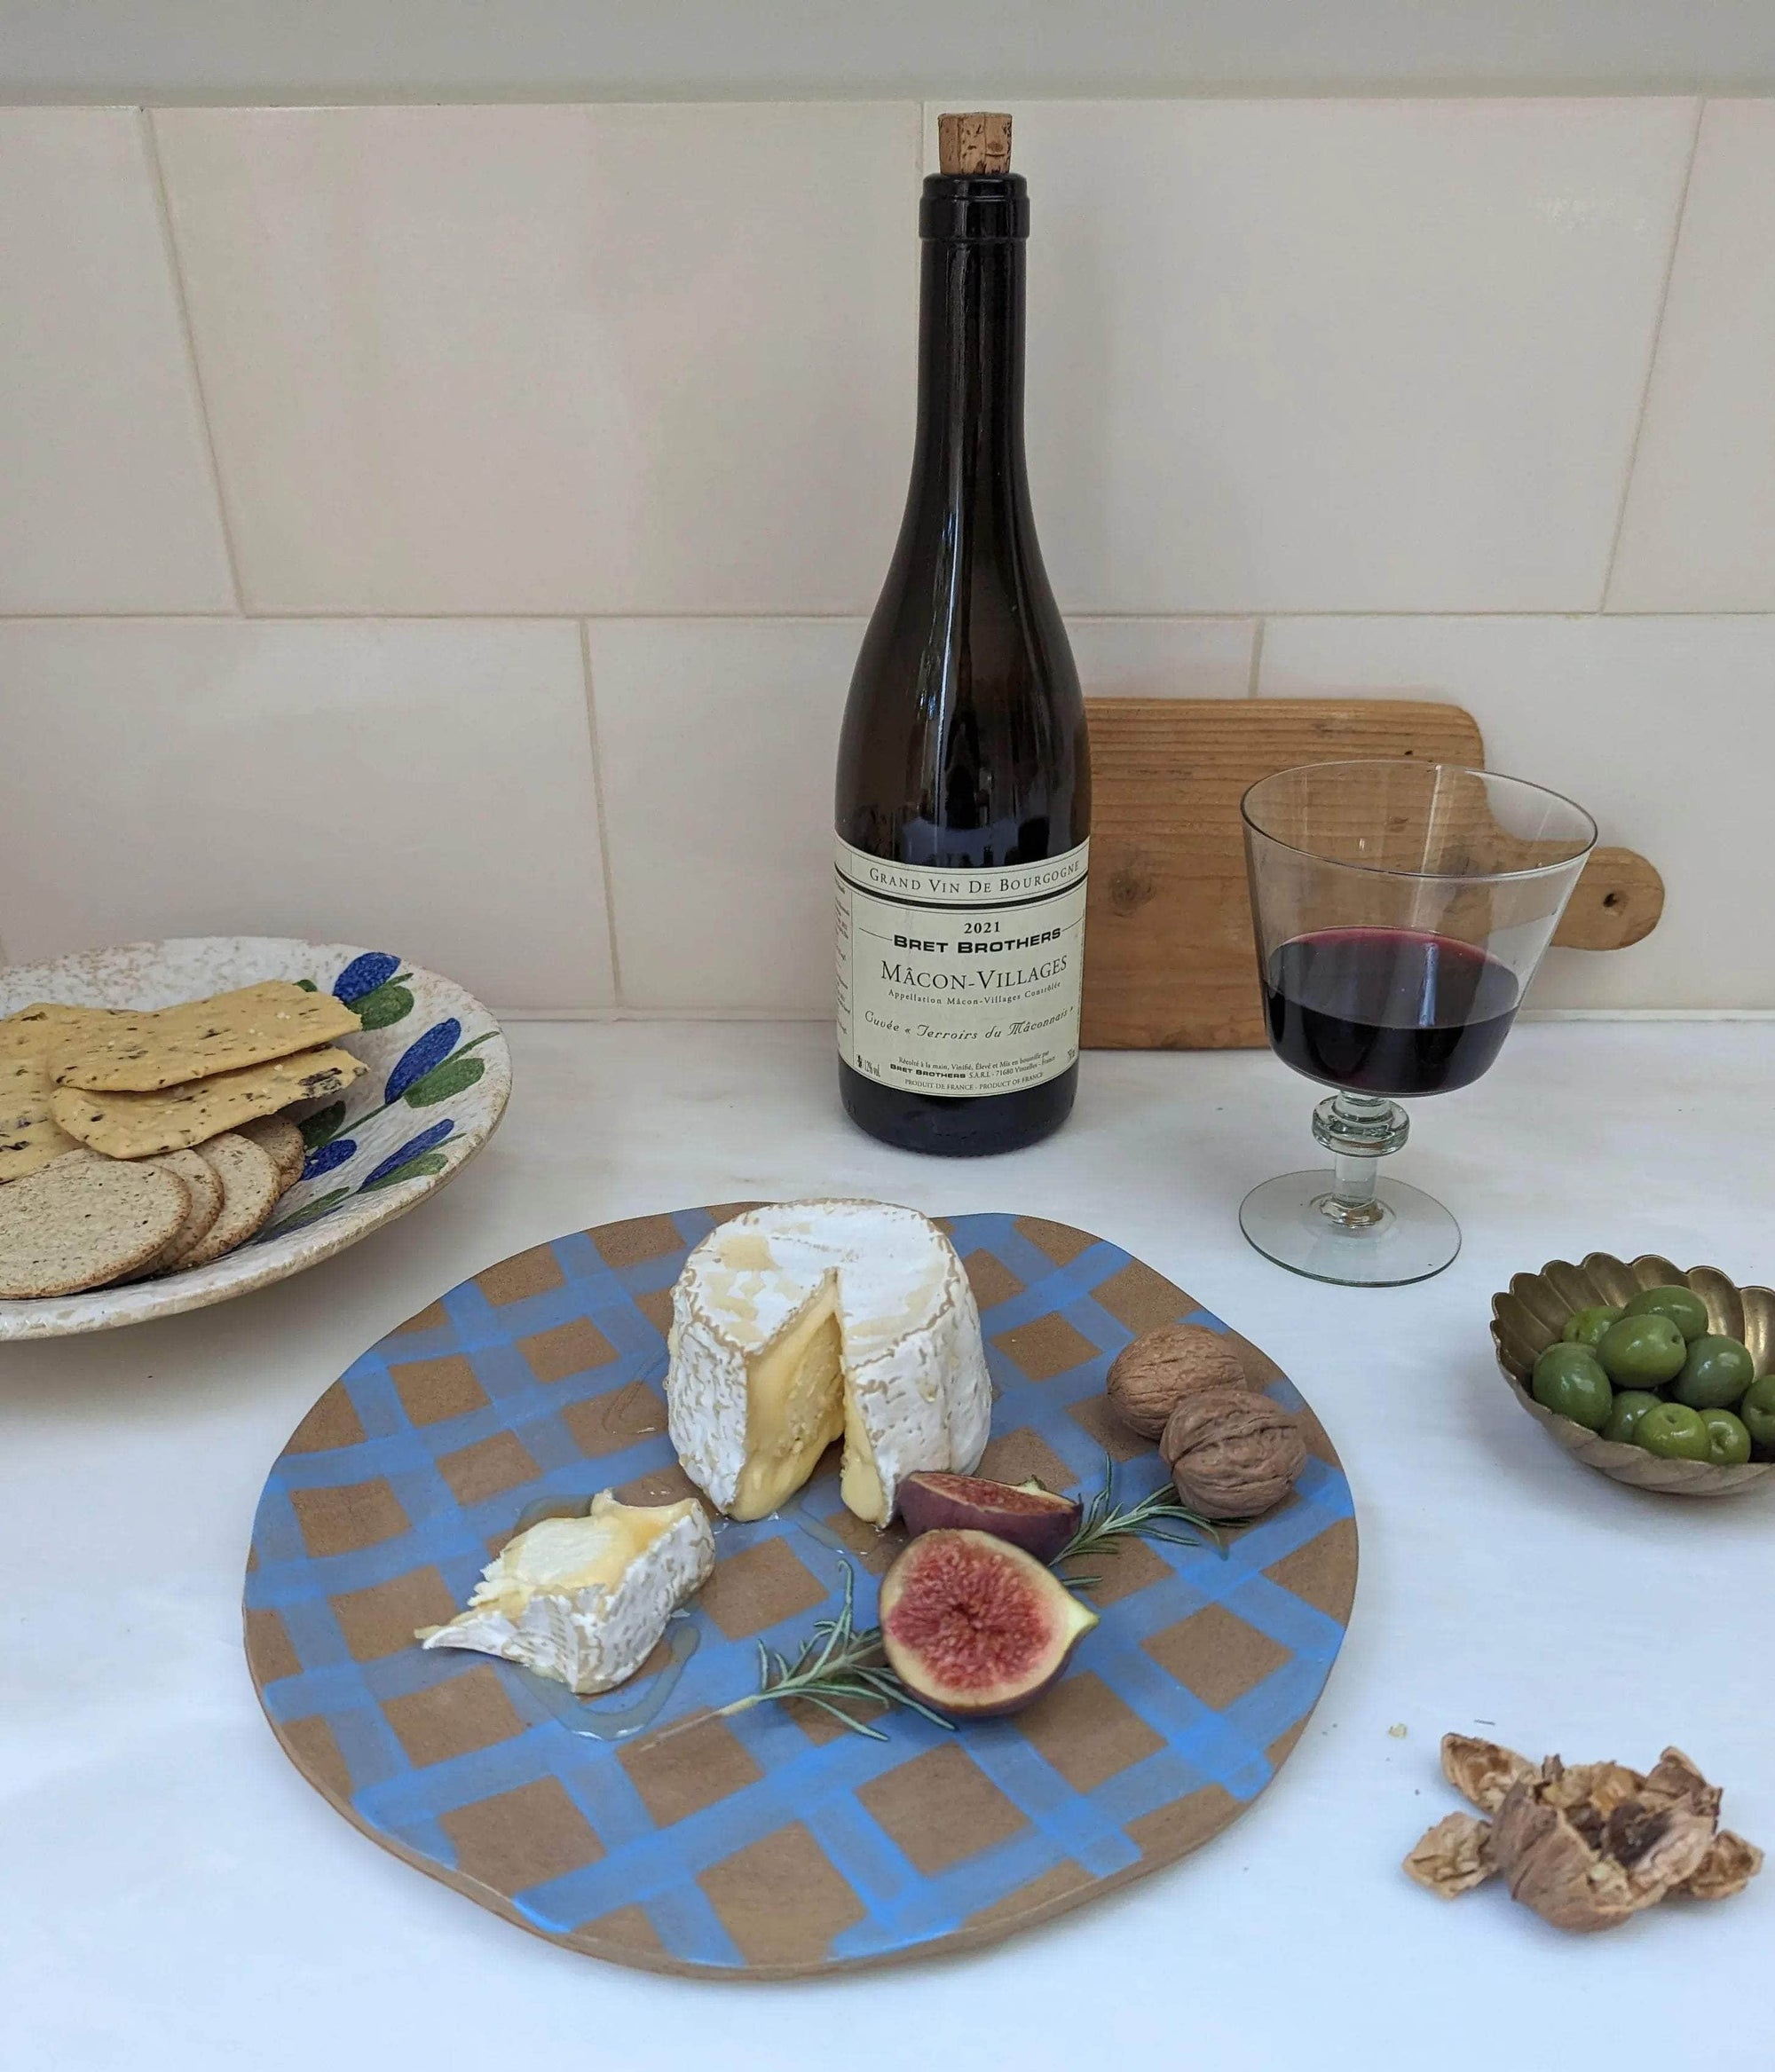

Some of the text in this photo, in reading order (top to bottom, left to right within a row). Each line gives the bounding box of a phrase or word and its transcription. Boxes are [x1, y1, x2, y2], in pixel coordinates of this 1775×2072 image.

[870, 860, 1080, 894] GRAND VIN DE BOURGOGNE
[894, 927, 1061, 953] BRET BROTHERS
[964, 921, 1000, 934] 2021
[881, 955, 1068, 990] MÂCON-VILLAGES
[888, 989, 942, 1004] Appellation
[947, 993, 1021, 1005] Mâcon-Villages
[864, 1010, 899, 1032] Cuvée
[917, 1024, 978, 1040] Terroirs
[985, 1025, 1002, 1039] du
[1008, 1008, 1069, 1036] Mâconnais
[890, 1063, 913, 1074] BRET
[916, 1069, 966, 1079] BROTHERS
